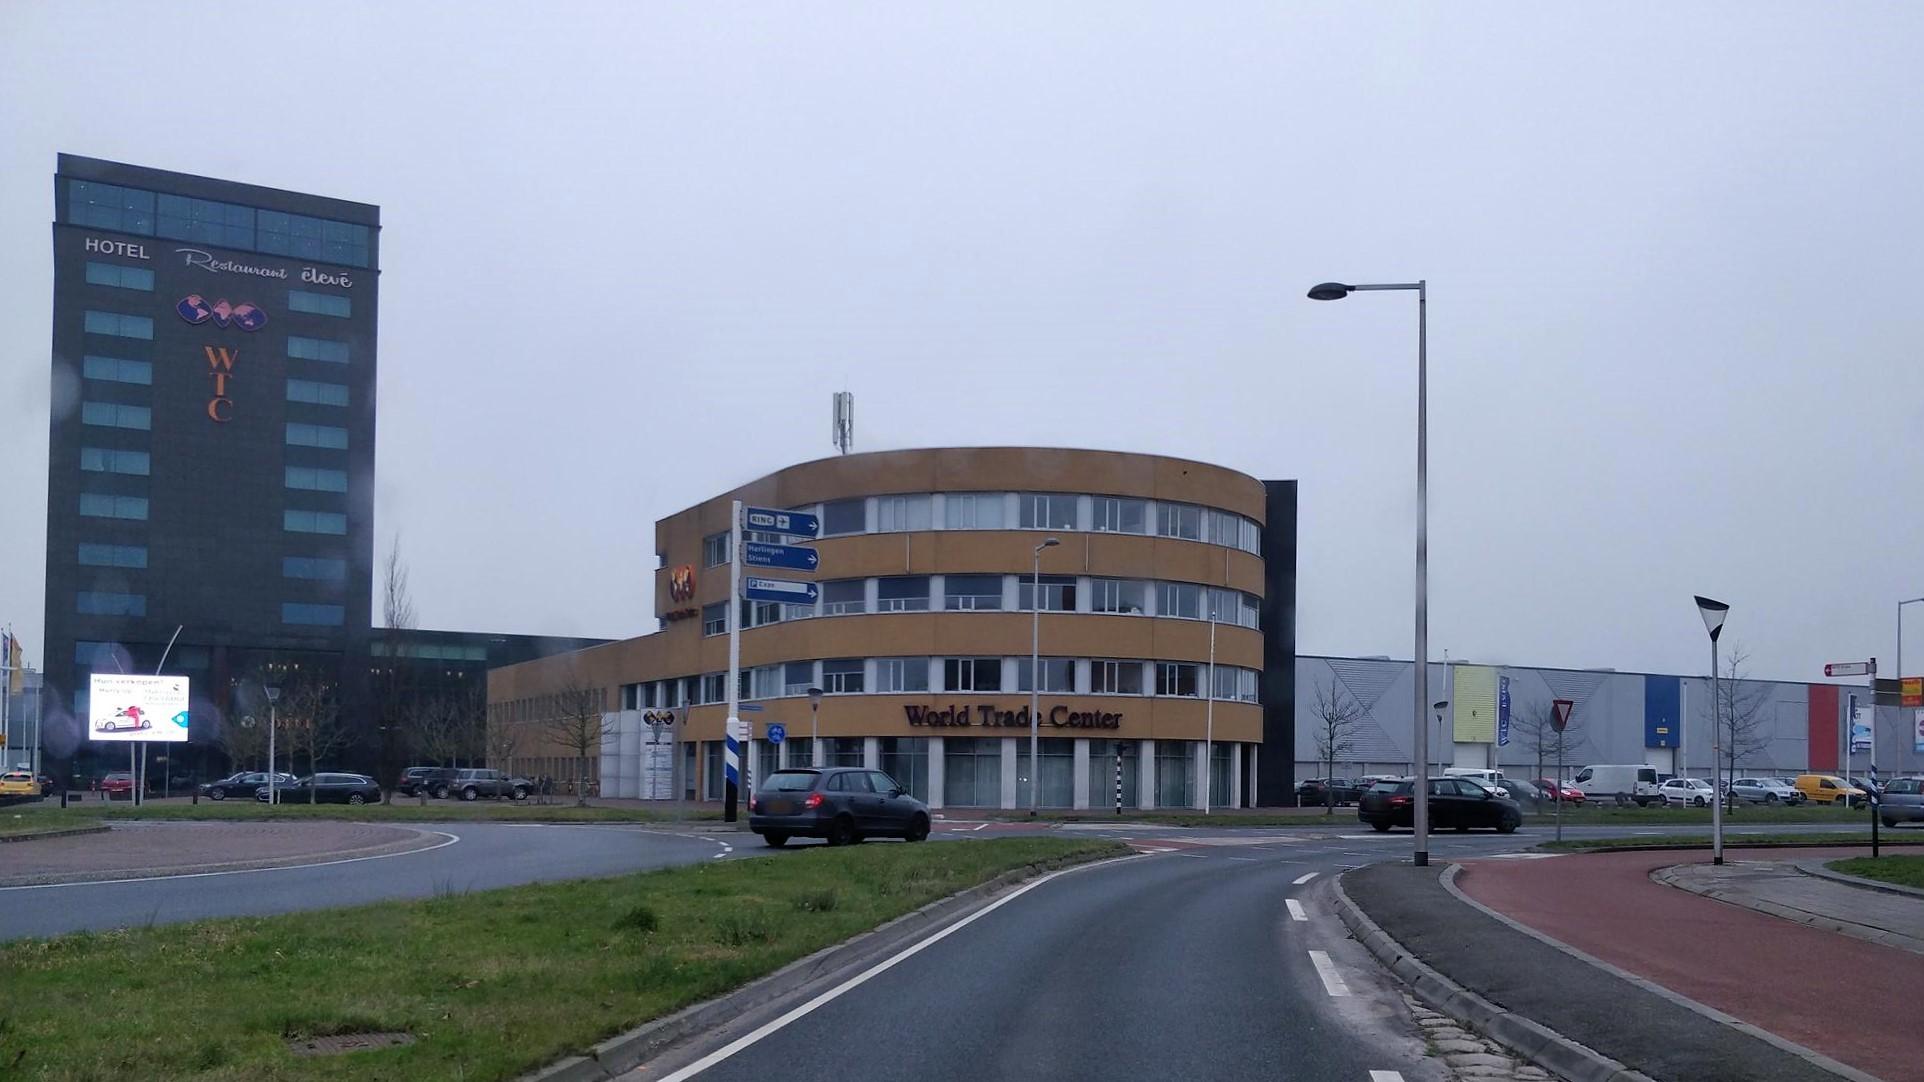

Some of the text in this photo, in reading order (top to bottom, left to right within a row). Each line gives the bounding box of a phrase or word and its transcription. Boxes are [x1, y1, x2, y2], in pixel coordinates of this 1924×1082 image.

[85, 237, 150, 259] HOTEL
[175, 248, 288, 280] Restaurant
[204, 345, 239, 422] WTC
[751, 515, 773, 524] RING
[904, 704, 1123, 729] World Trade Center
